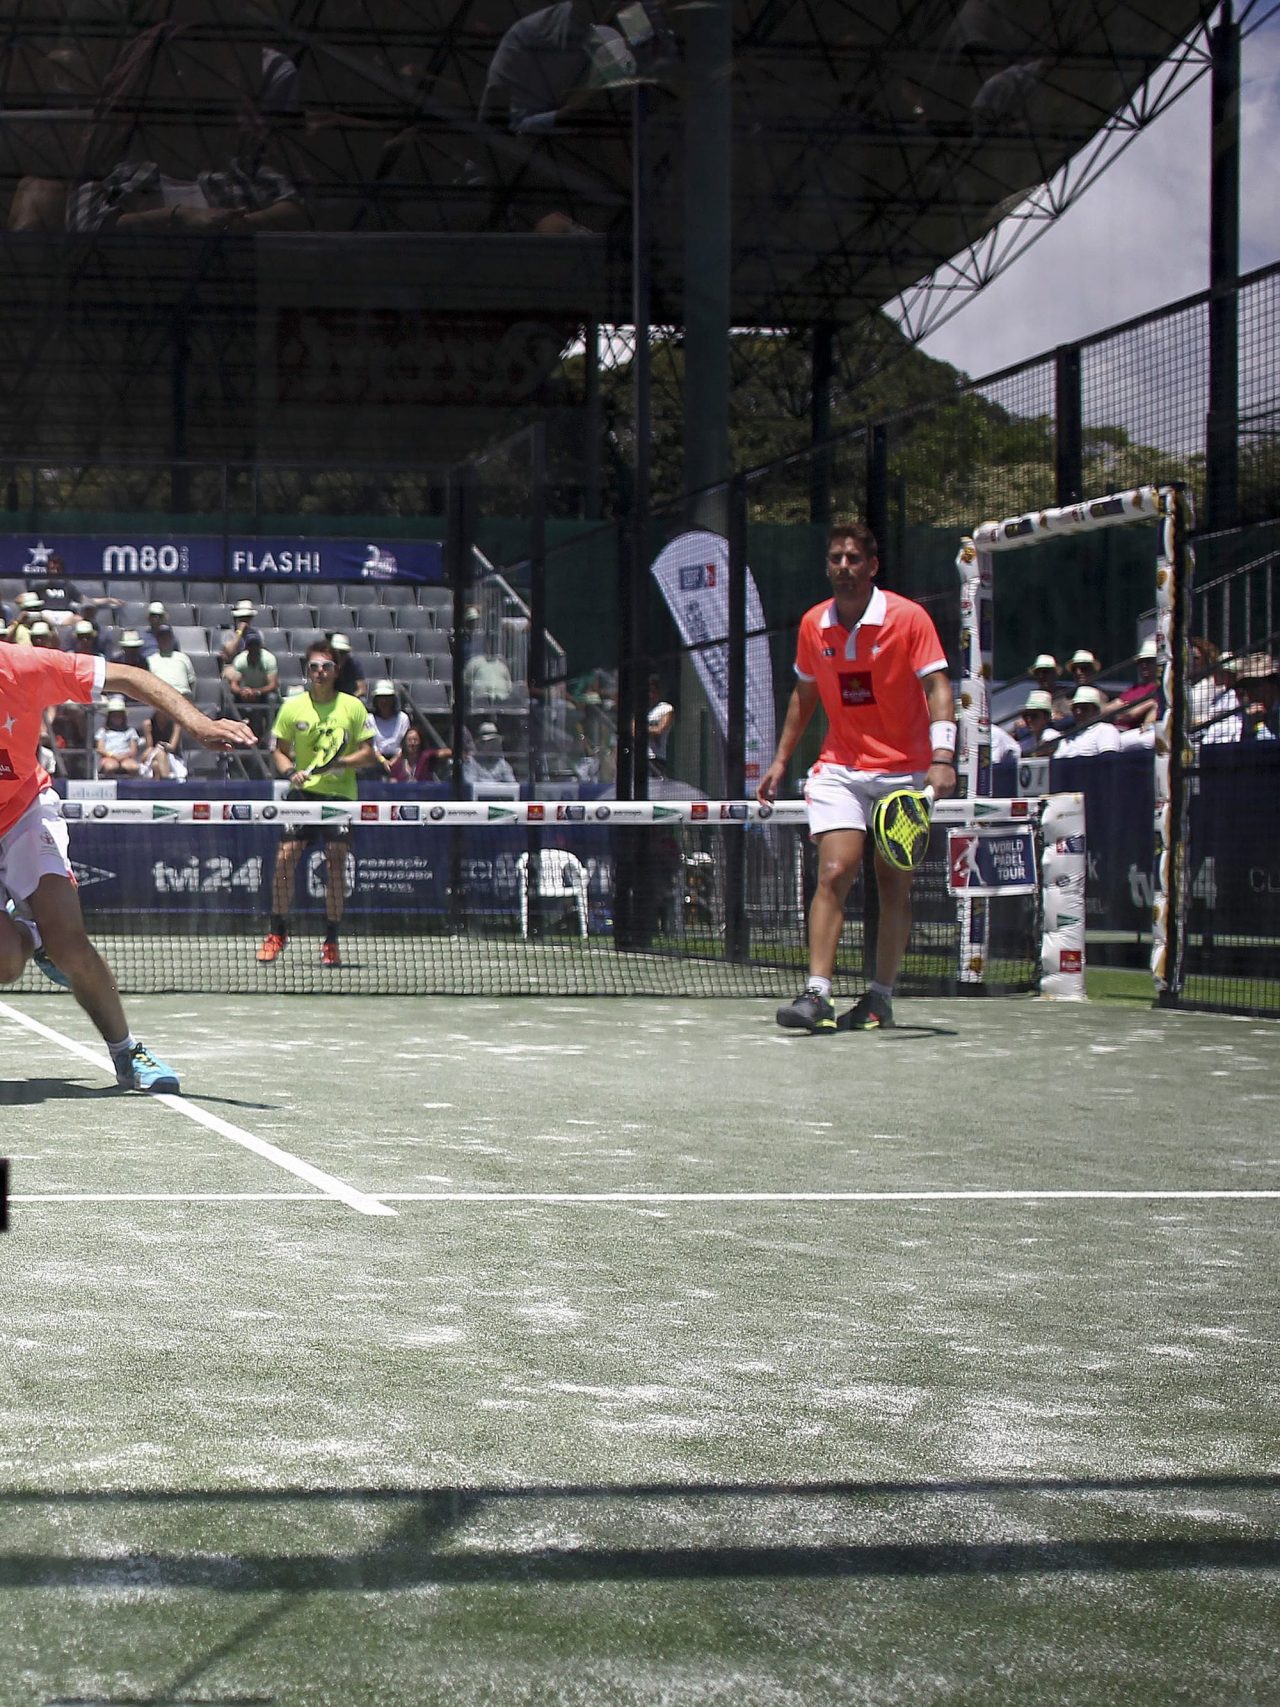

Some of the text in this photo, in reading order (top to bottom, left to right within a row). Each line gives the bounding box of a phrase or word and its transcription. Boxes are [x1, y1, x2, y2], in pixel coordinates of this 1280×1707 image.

[102, 544, 179, 573] m80
[232, 550, 320, 574] FLASH!
[988, 839, 1024, 854] WORLD
[993, 852, 1026, 868] PADEL
[152, 856, 262, 893] tvi24
[997, 866, 1026, 881] TOUR
